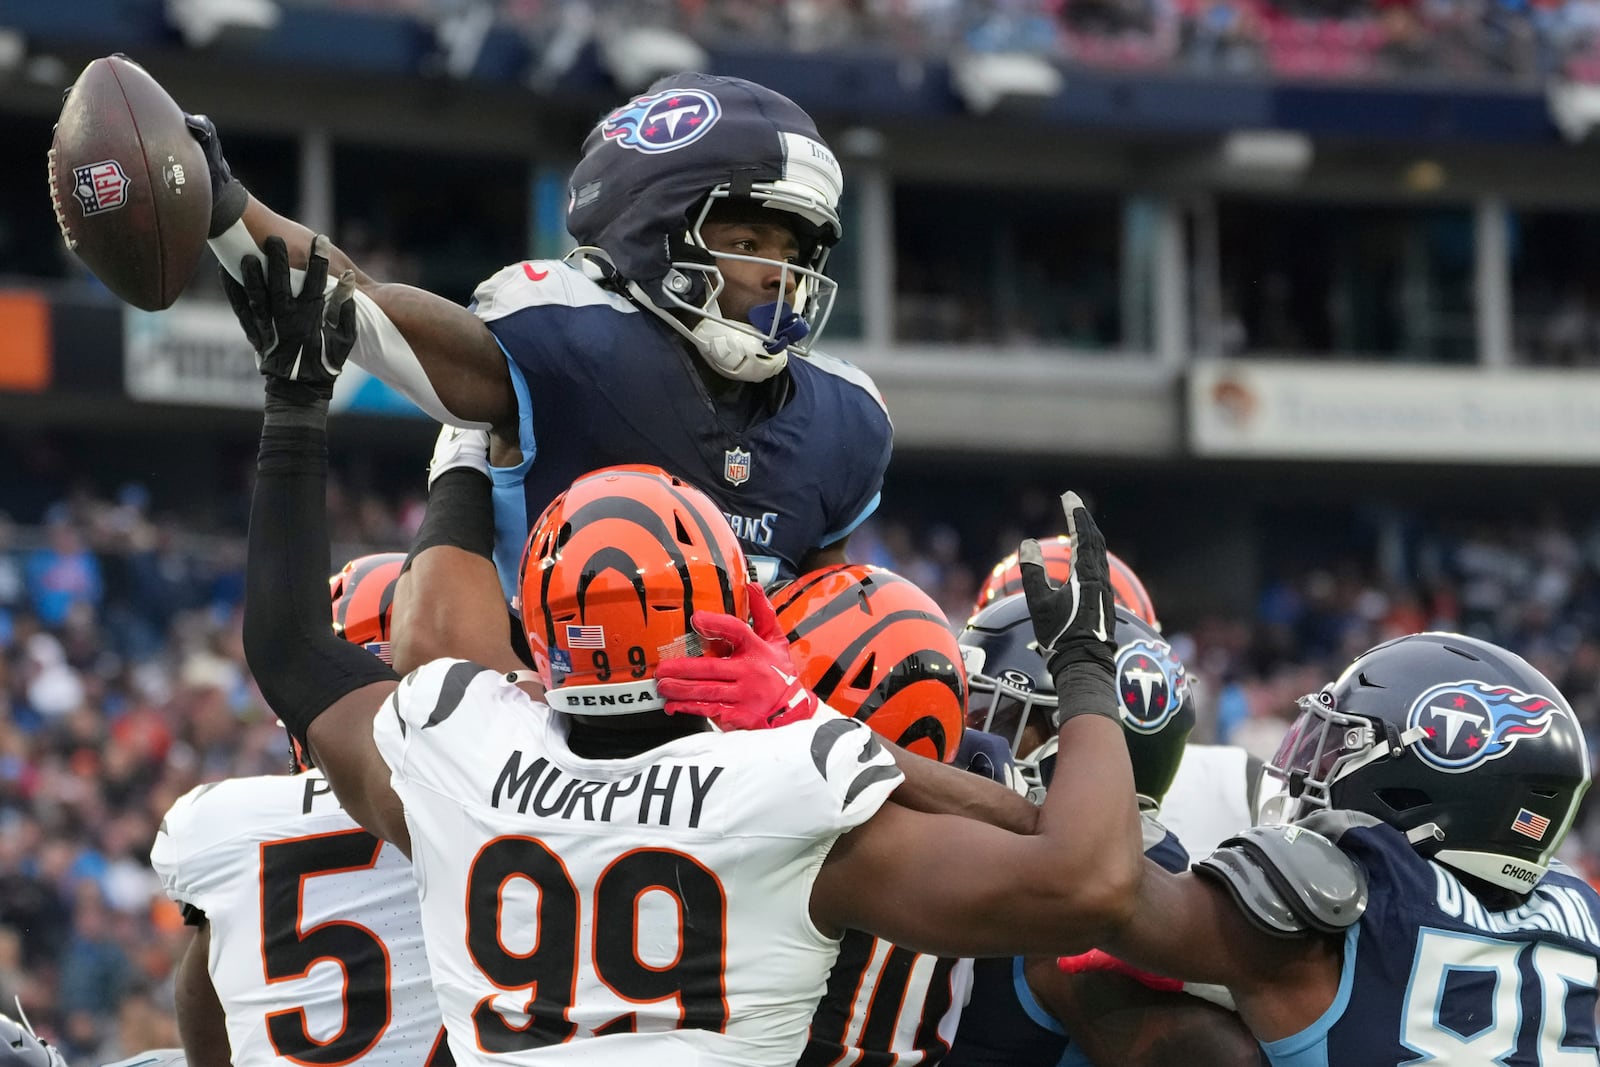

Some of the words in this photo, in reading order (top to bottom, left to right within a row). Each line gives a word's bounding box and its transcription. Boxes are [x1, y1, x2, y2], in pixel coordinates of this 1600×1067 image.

[93, 165, 122, 207] NFL
[566, 691, 655, 706] BENGA
[491, 750, 725, 829] MURPHY
[1501, 863, 1538, 885] CHOOS
[259, 827, 446, 1067] 5
[465, 834, 730, 1054] 99
